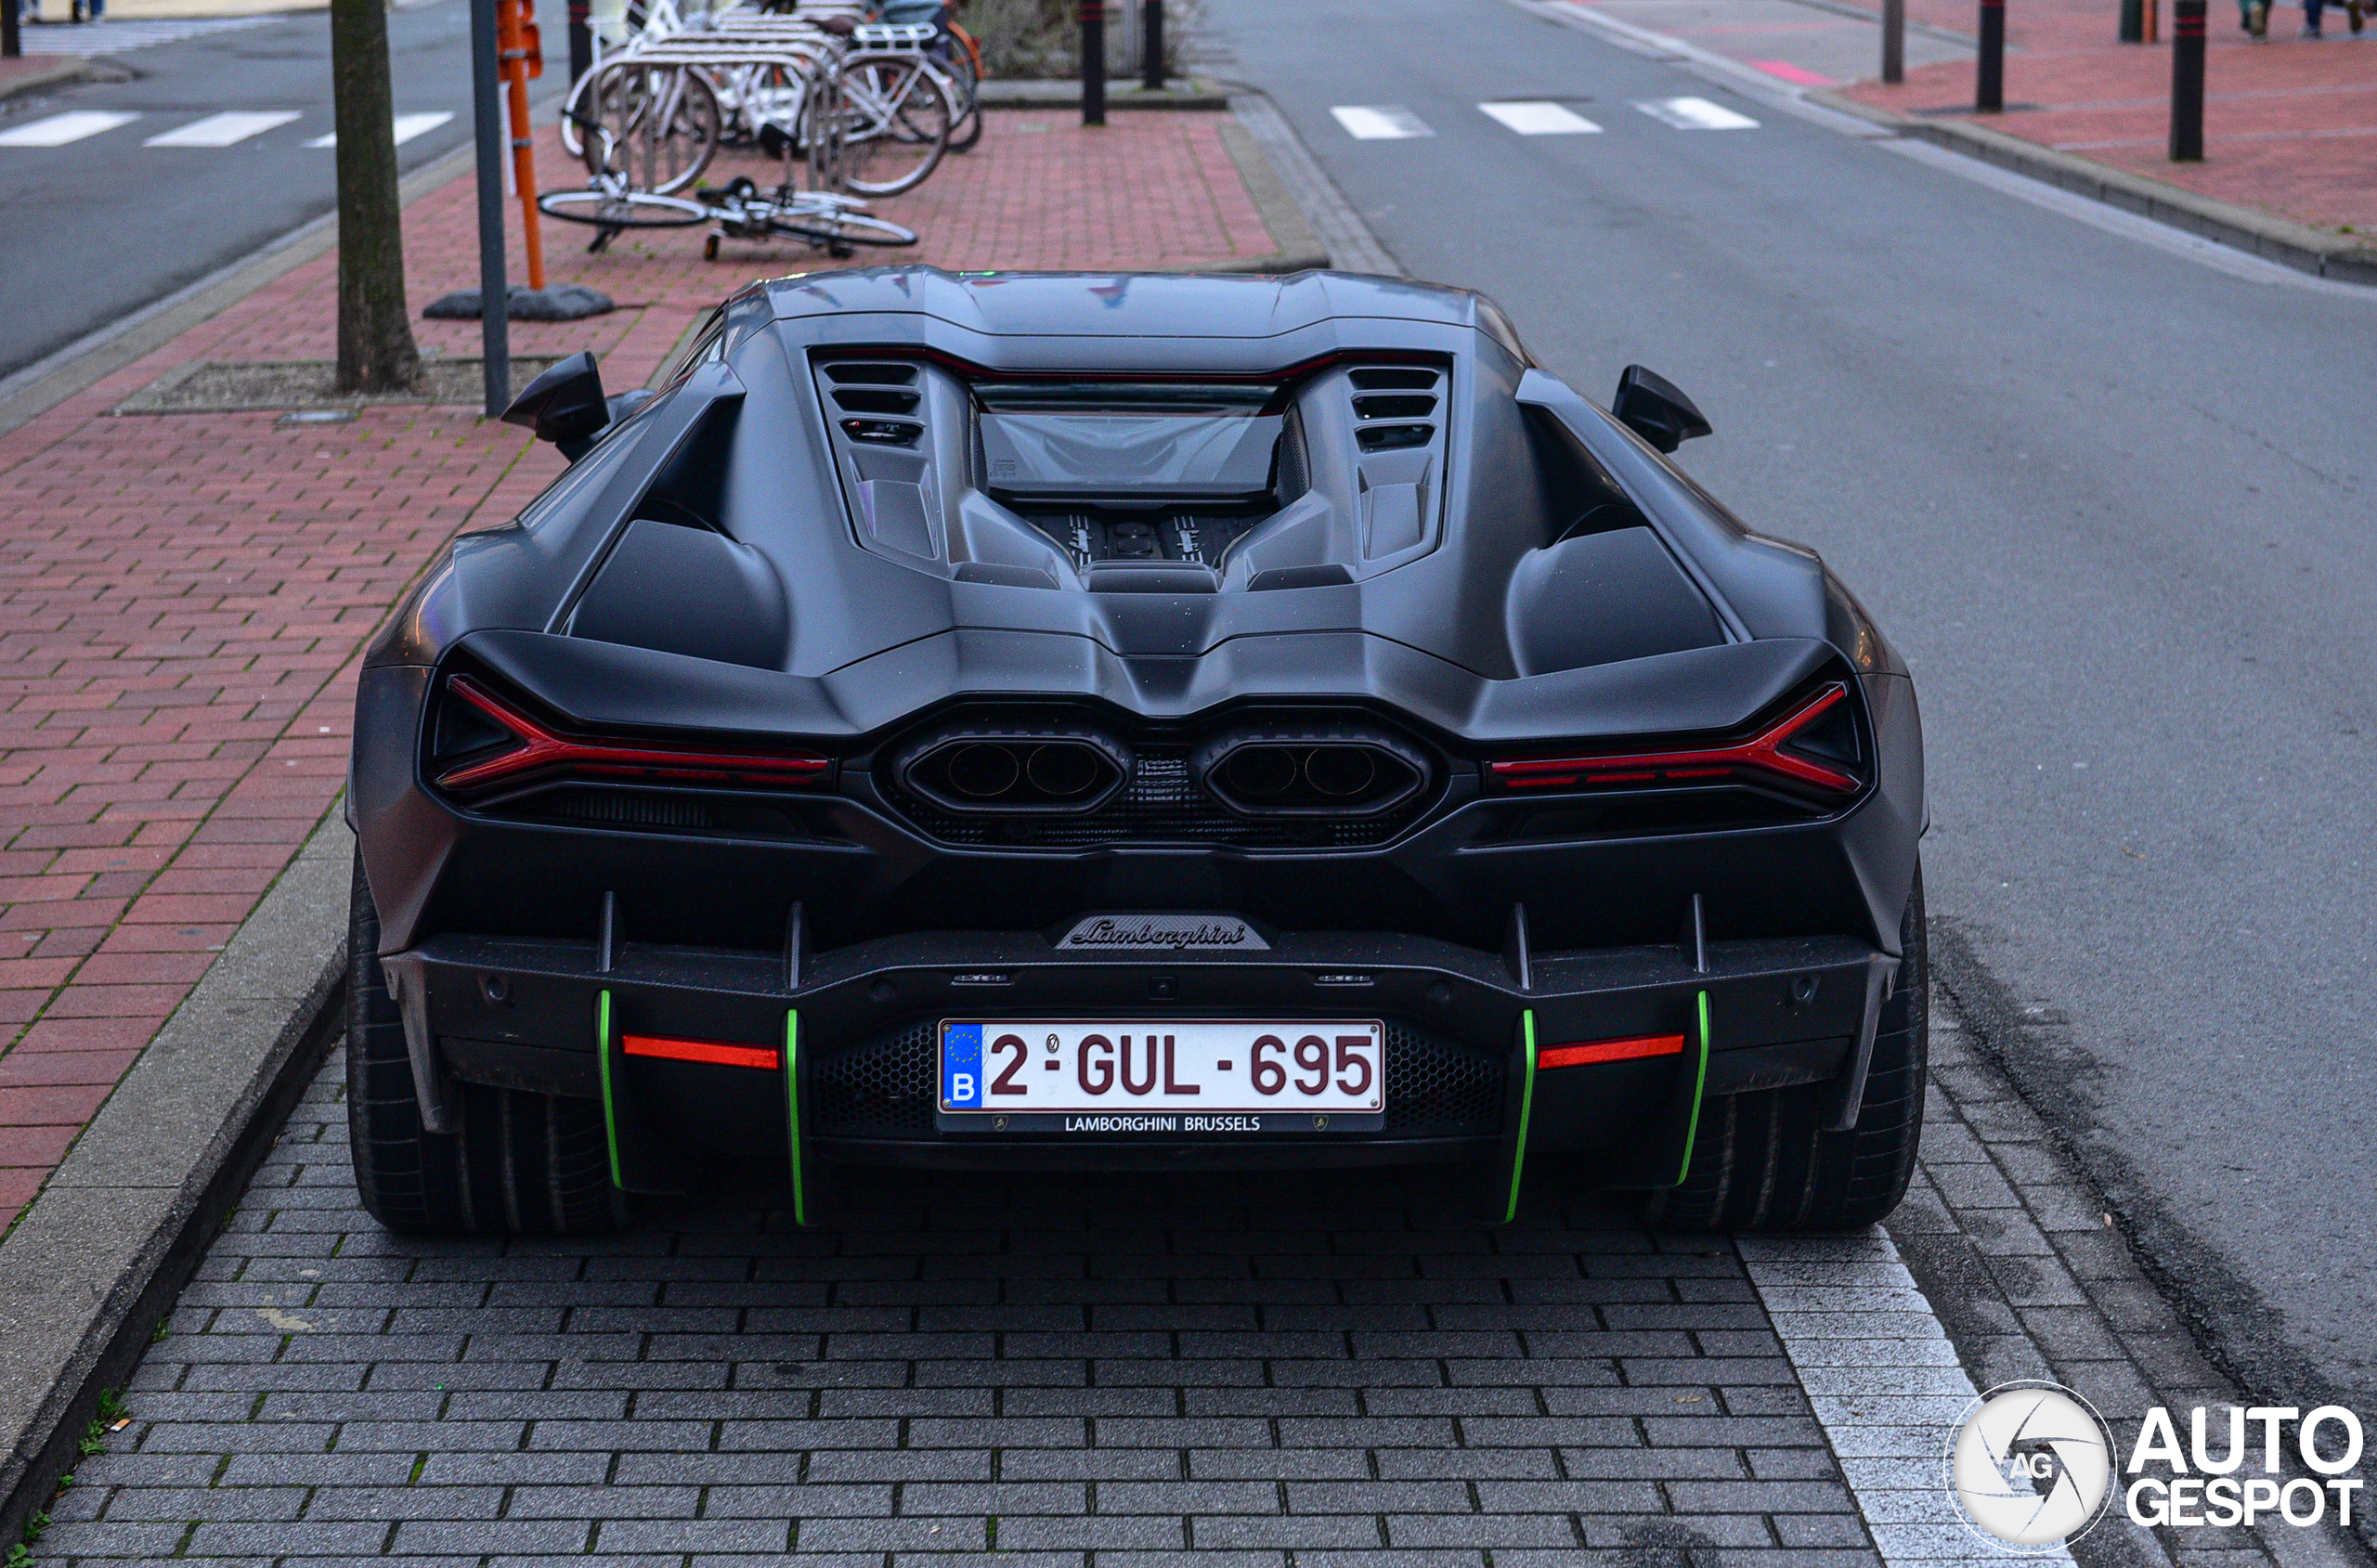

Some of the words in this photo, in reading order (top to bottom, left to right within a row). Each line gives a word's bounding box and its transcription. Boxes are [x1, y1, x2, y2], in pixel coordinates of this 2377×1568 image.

[1071, 919, 1246, 950] Lamborghini
[952, 1073, 976, 1102] B
[1065, 1117, 1177, 1132] LAMBORGHINI
[1185, 1117, 1261, 1132] BRUSSELS
